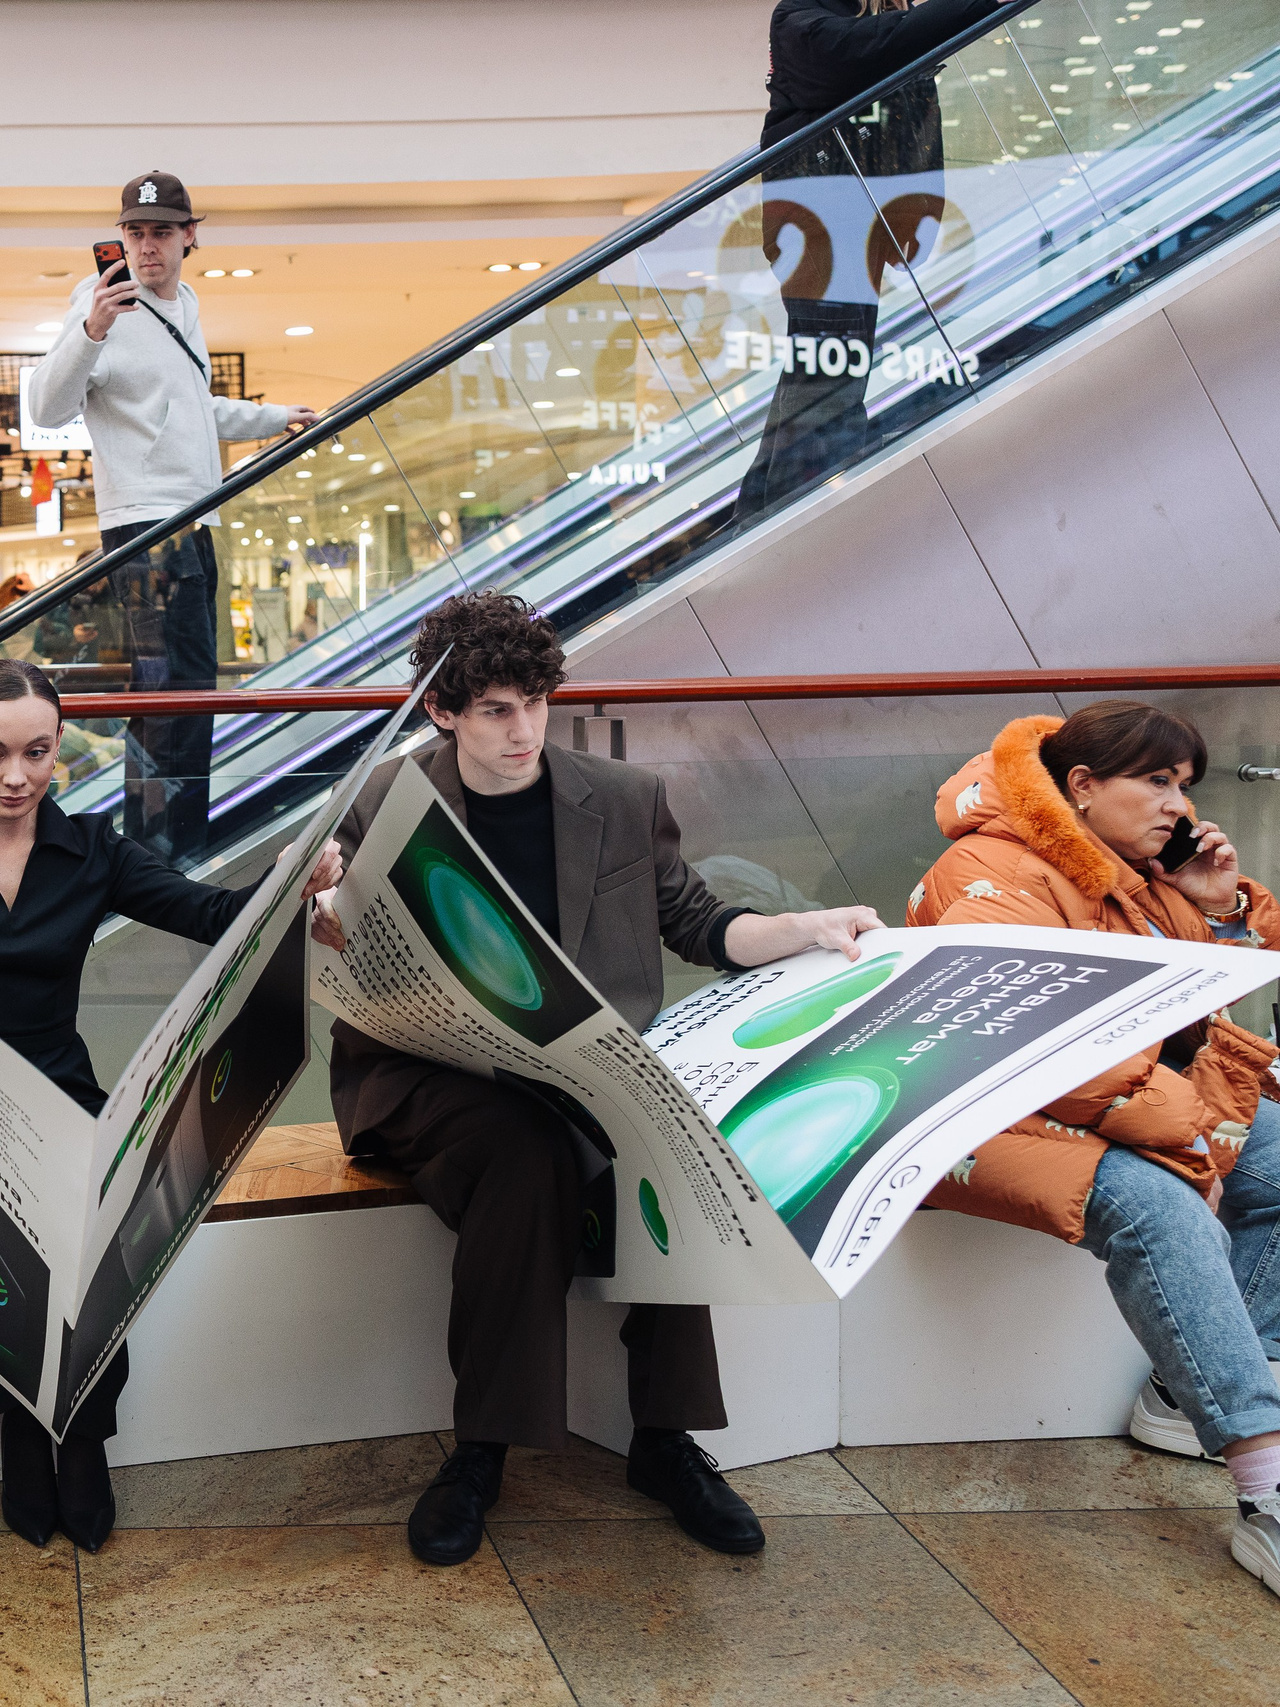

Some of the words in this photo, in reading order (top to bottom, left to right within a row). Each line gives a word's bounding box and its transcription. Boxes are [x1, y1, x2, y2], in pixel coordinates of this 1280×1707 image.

[339, 948, 401, 1024] Сбера.
[352, 930, 361, 945] с
[362, 950, 425, 1025] новым
[357, 919, 386, 970] Это
[389, 975, 514, 1067] возможно
[363, 912, 470, 1036] банкомат?
[368, 903, 457, 1020] здоровье
[463, 1023, 545, 1071] через
[373, 892, 415, 960] Хоть
[417, 965, 456, 1007] раз
[461, 1011, 595, 1098] проверял
[877, 967, 952, 1018] технологии
[911, 959, 1027, 1026] Сбера
[927, 961, 975, 992] умным
[949, 955, 969, 966] на
[970, 955, 983, 963] с
[1141, 970, 1230, 1018] декабрь
[346, 937, 474, 1057] банкоматом
[639, 988, 720, 1038] Афимо
[654, 969, 786, 1054] Попробуйт
[665, 973, 761, 1032] первым
[844, 992, 930, 1052] помощником
[895, 961, 1068, 1066] банкомат
[973, 964, 1109, 1036] Новый
[1092, 1015, 1150, 1047] 2025
[134, 934, 262, 1152] СБЕРА
[604, 1032, 686, 1114] экран
[829, 1018, 881, 1056] ГигаЧат
[616, 1026, 759, 1203] Отдельный
[687, 1060, 735, 1099] Сбе
[700, 1060, 760, 1111] Банк
[595, 1037, 754, 1247] безопасности
[68, 1280, 152, 1408] Попробуйте
[149, 1202, 203, 1279] первым
[210, 1077, 284, 1184] Афимолле!
[846, 1196, 892, 1269] СБЕР
